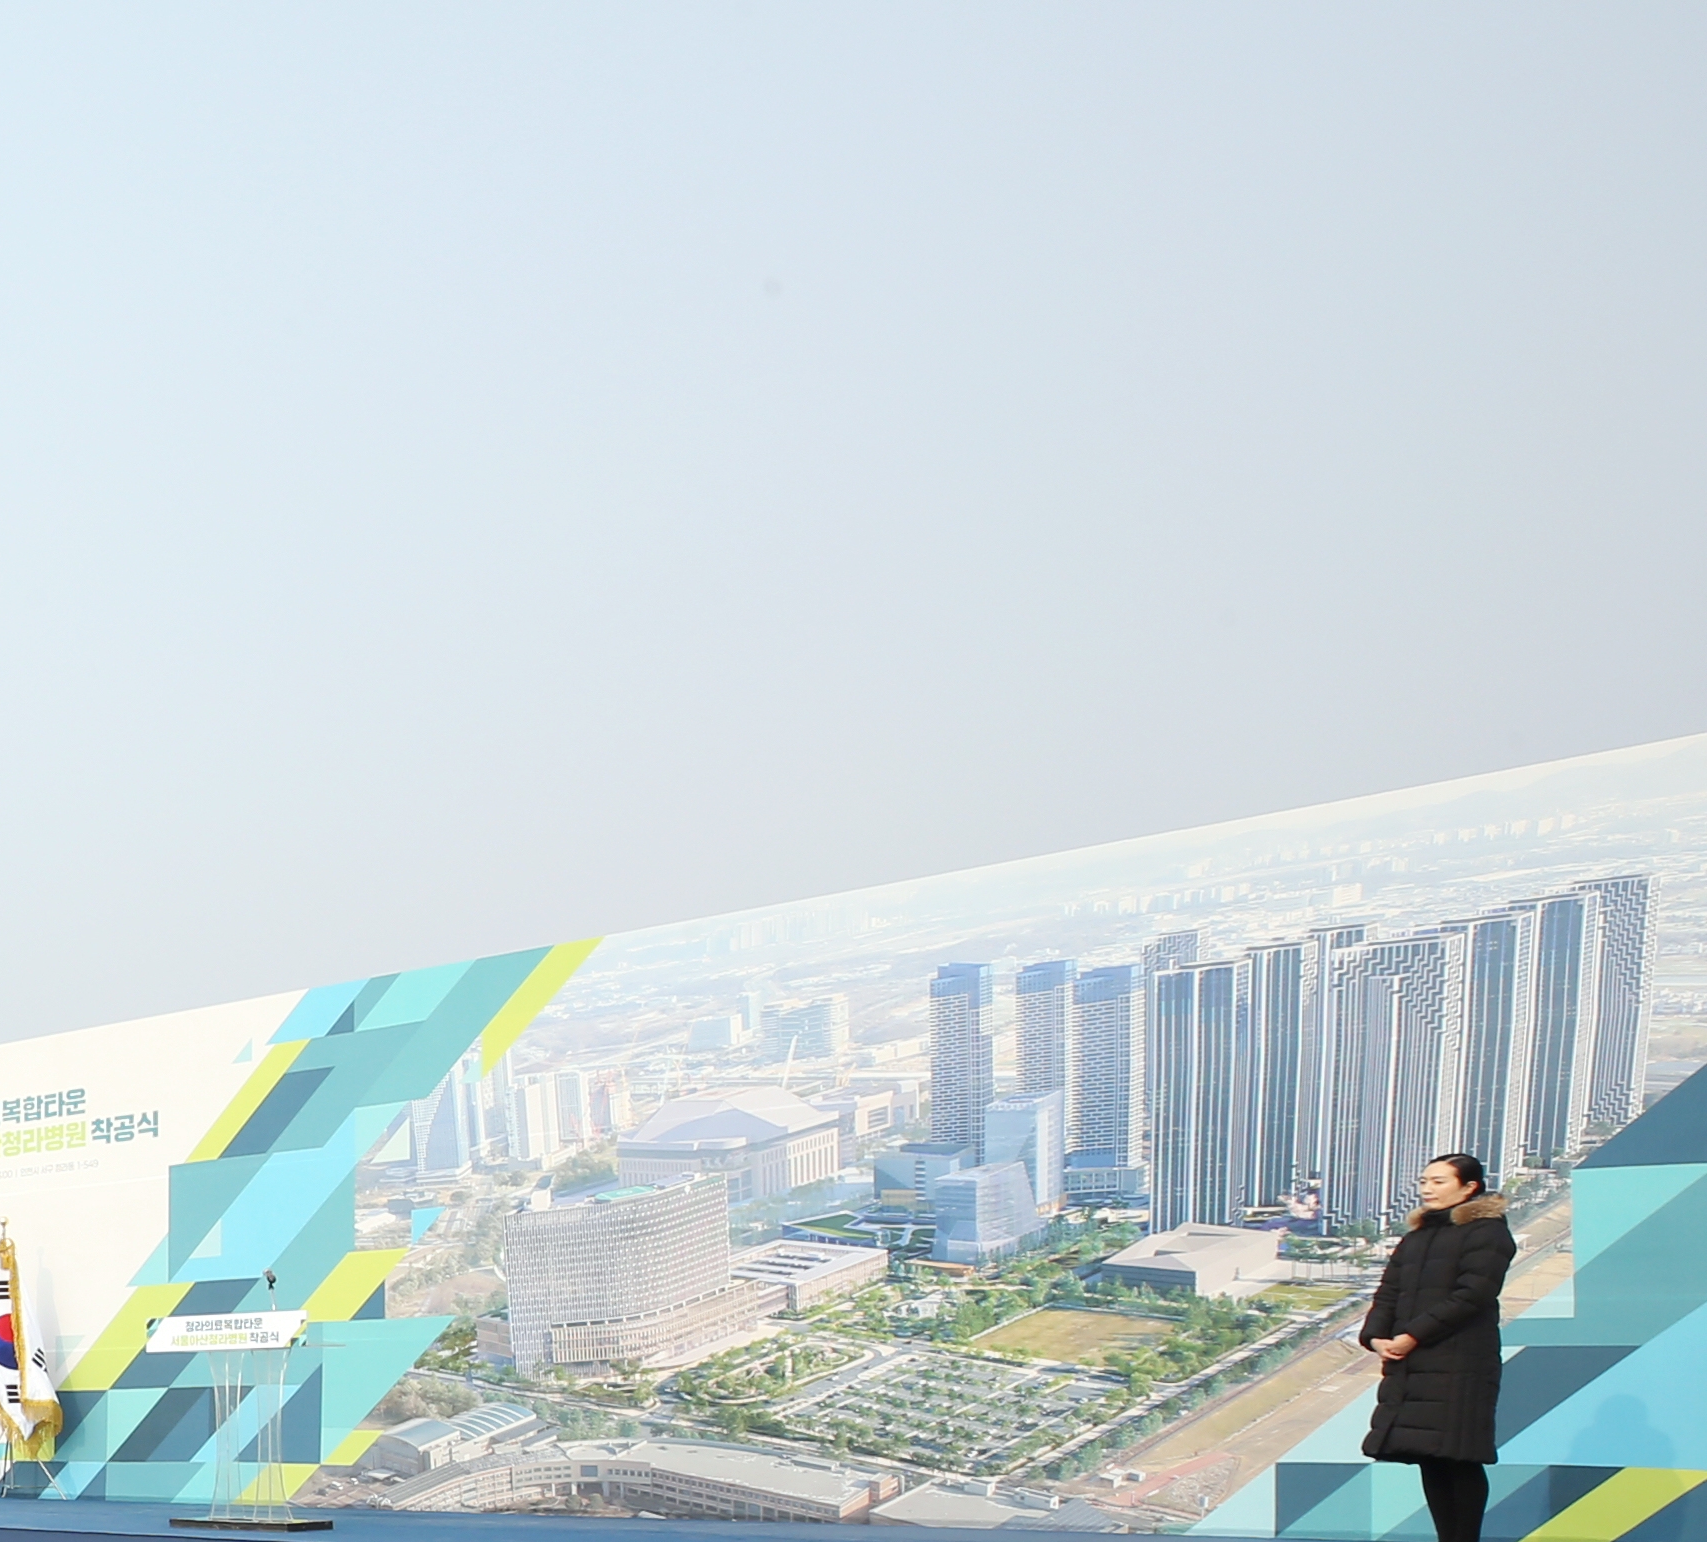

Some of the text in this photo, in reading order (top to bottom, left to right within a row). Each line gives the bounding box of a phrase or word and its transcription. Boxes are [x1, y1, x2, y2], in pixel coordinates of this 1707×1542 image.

[91, 1110, 160, 1144] 착공식
[185, 1318, 263, 1332] 청라의료복합타운
[249, 1332, 280, 1344] 착공식
